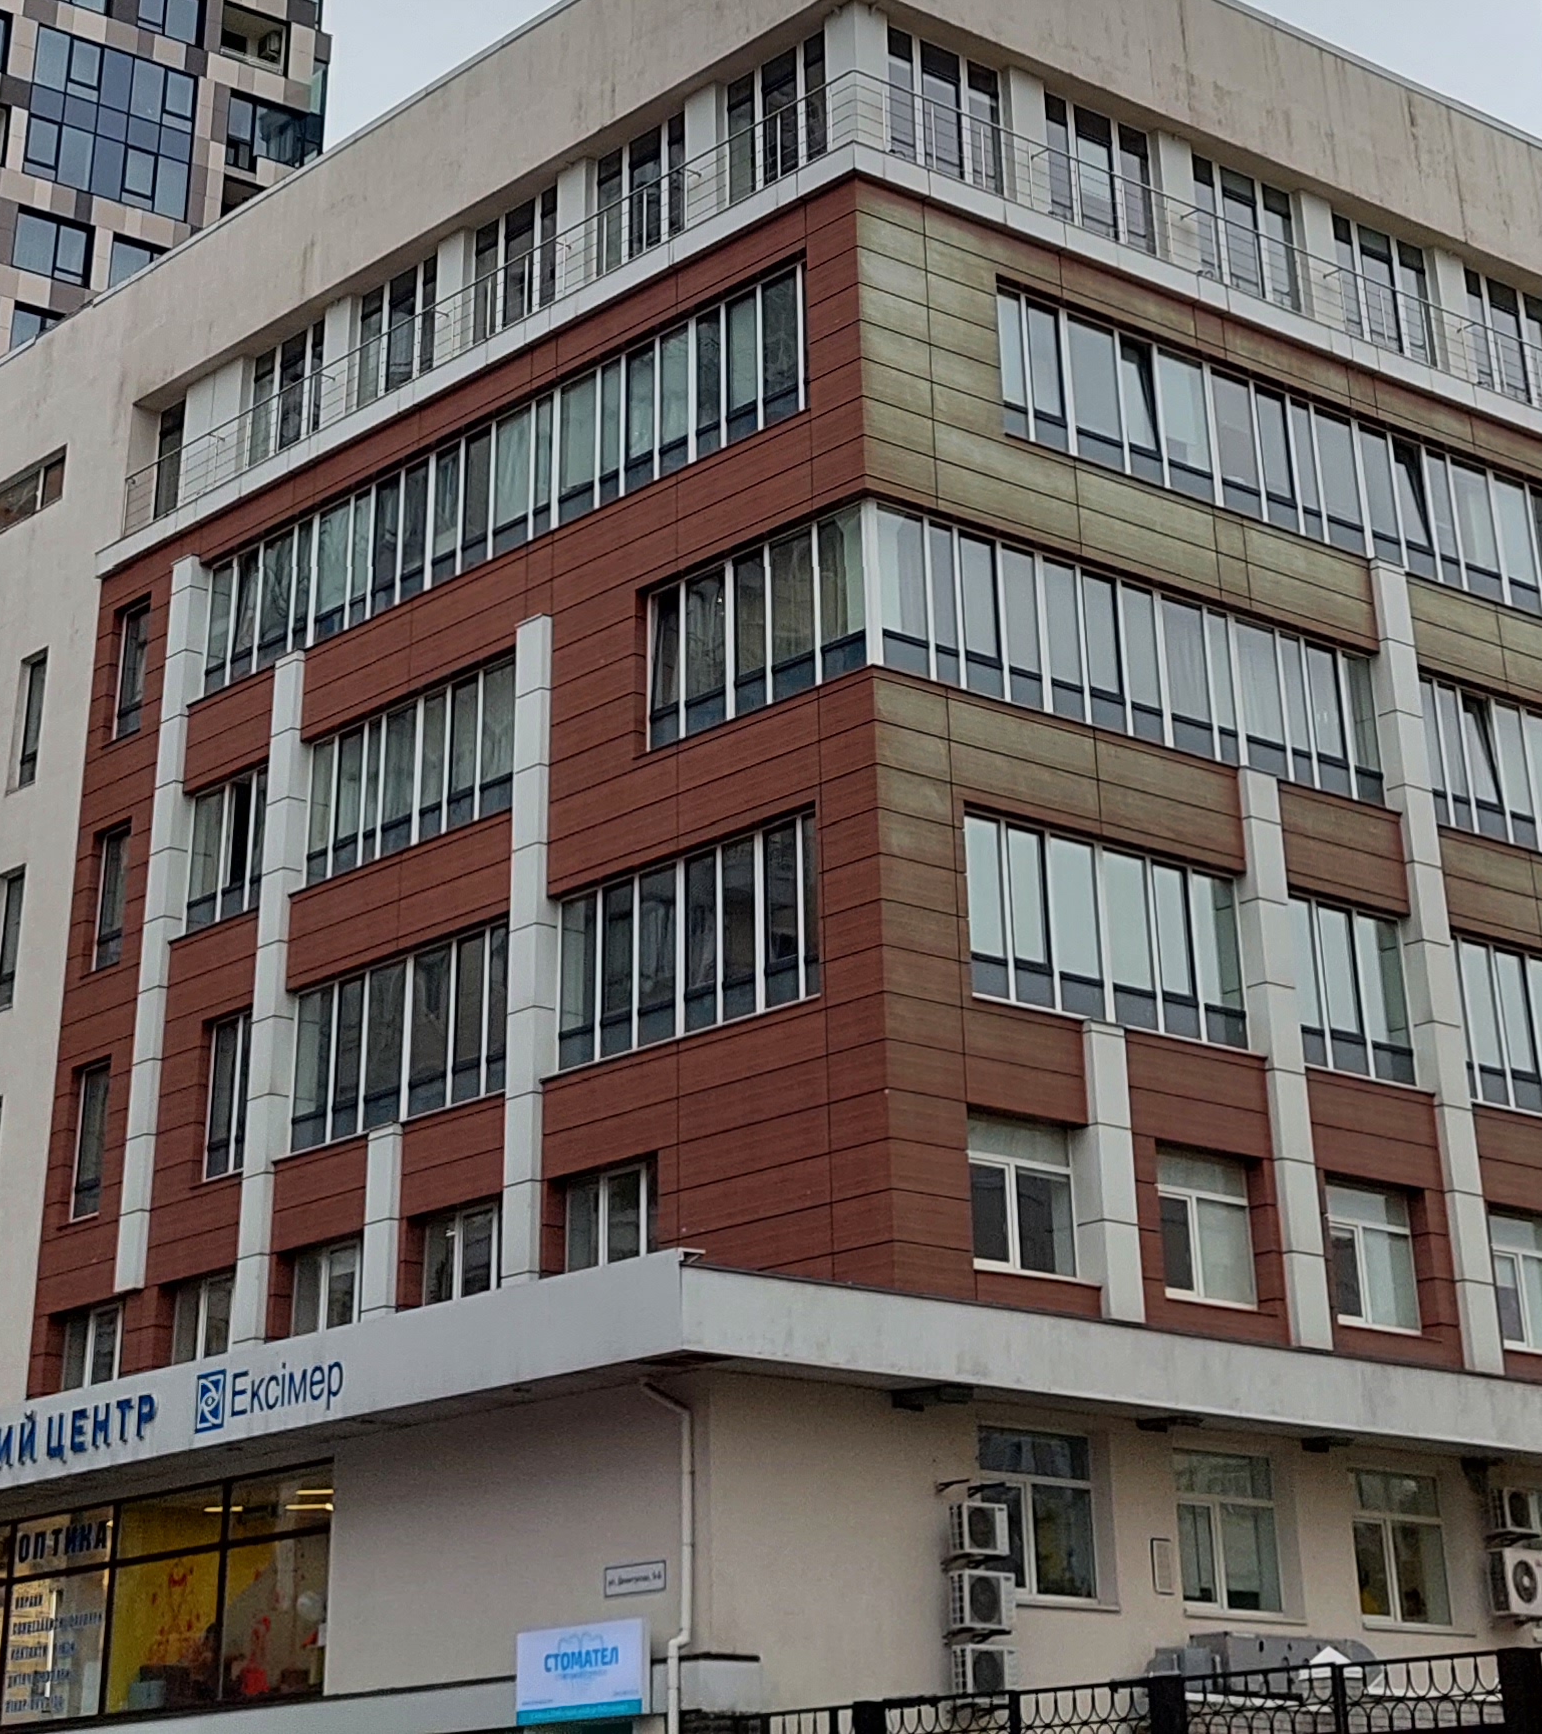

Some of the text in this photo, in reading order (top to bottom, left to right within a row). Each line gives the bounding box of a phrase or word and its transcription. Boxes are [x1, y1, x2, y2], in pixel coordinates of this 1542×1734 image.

[230, 1360, 345, 1418] Ексімер
[46, 1393, 158, 1464] ЦЕНТР
[18, 1520, 109, 1564] ОПТИКА
[544, 1646, 619, 1673] СТОМАТЕЛ
